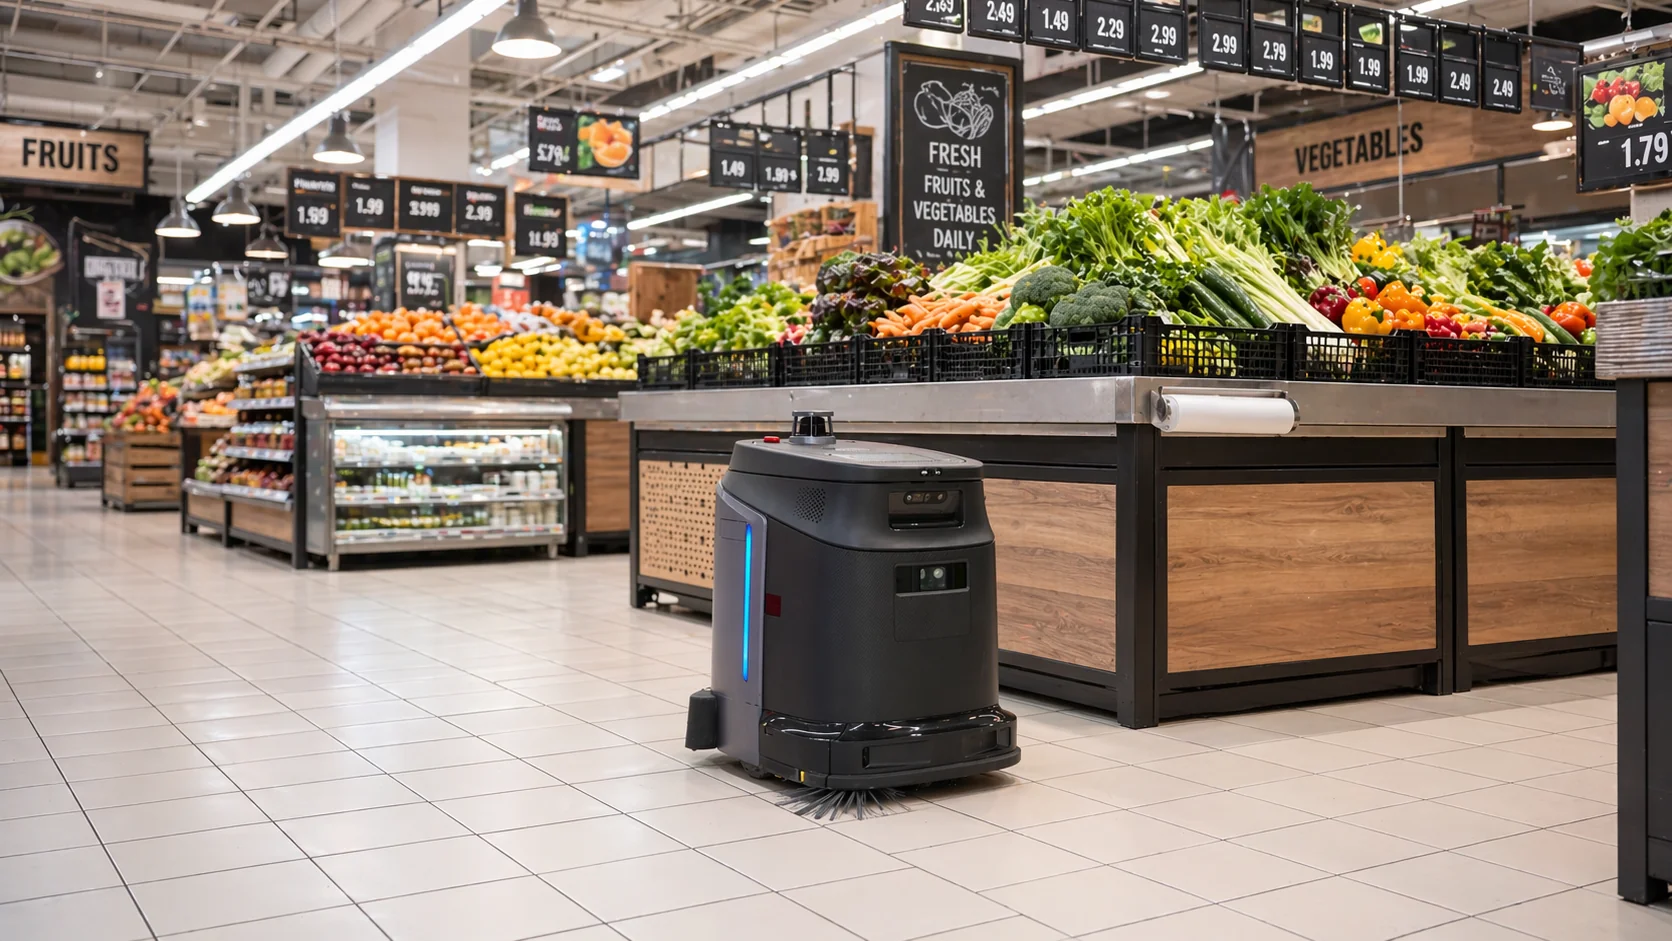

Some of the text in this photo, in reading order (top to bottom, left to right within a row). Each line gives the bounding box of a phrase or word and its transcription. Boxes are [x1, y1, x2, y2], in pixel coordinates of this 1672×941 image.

[986, 0, 1015, 24] 2.49
[1042, 8, 1069, 31] 1.49
[1097, 16, 1124, 39] 2.29
[1151, 24, 1177, 46] 2.99
[1212, 33, 1237, 55] 2.99
[1311, 50, 1334, 70] 1.99
[1358, 57, 1381, 77] 1.99
[1406, 64, 1429, 85] 1.99
[1450, 71, 1471, 91] 2.49
[1493, 78, 1514, 98] 2.49
[22, 138, 119, 172] FRUITS
[929, 141, 982, 168] FRESH
[1295, 122, 1424, 175] VEGETABLES
[1621, 132, 1669, 168] 1.79
[721, 159, 746, 177] 1.49
[816, 166, 840, 184] 2.99
[924, 174, 986, 199] FRUITS &
[355, 197, 384, 216] 1.99
[913, 200, 996, 226] VEGETABLES
[933, 227, 975, 251] DAILY
